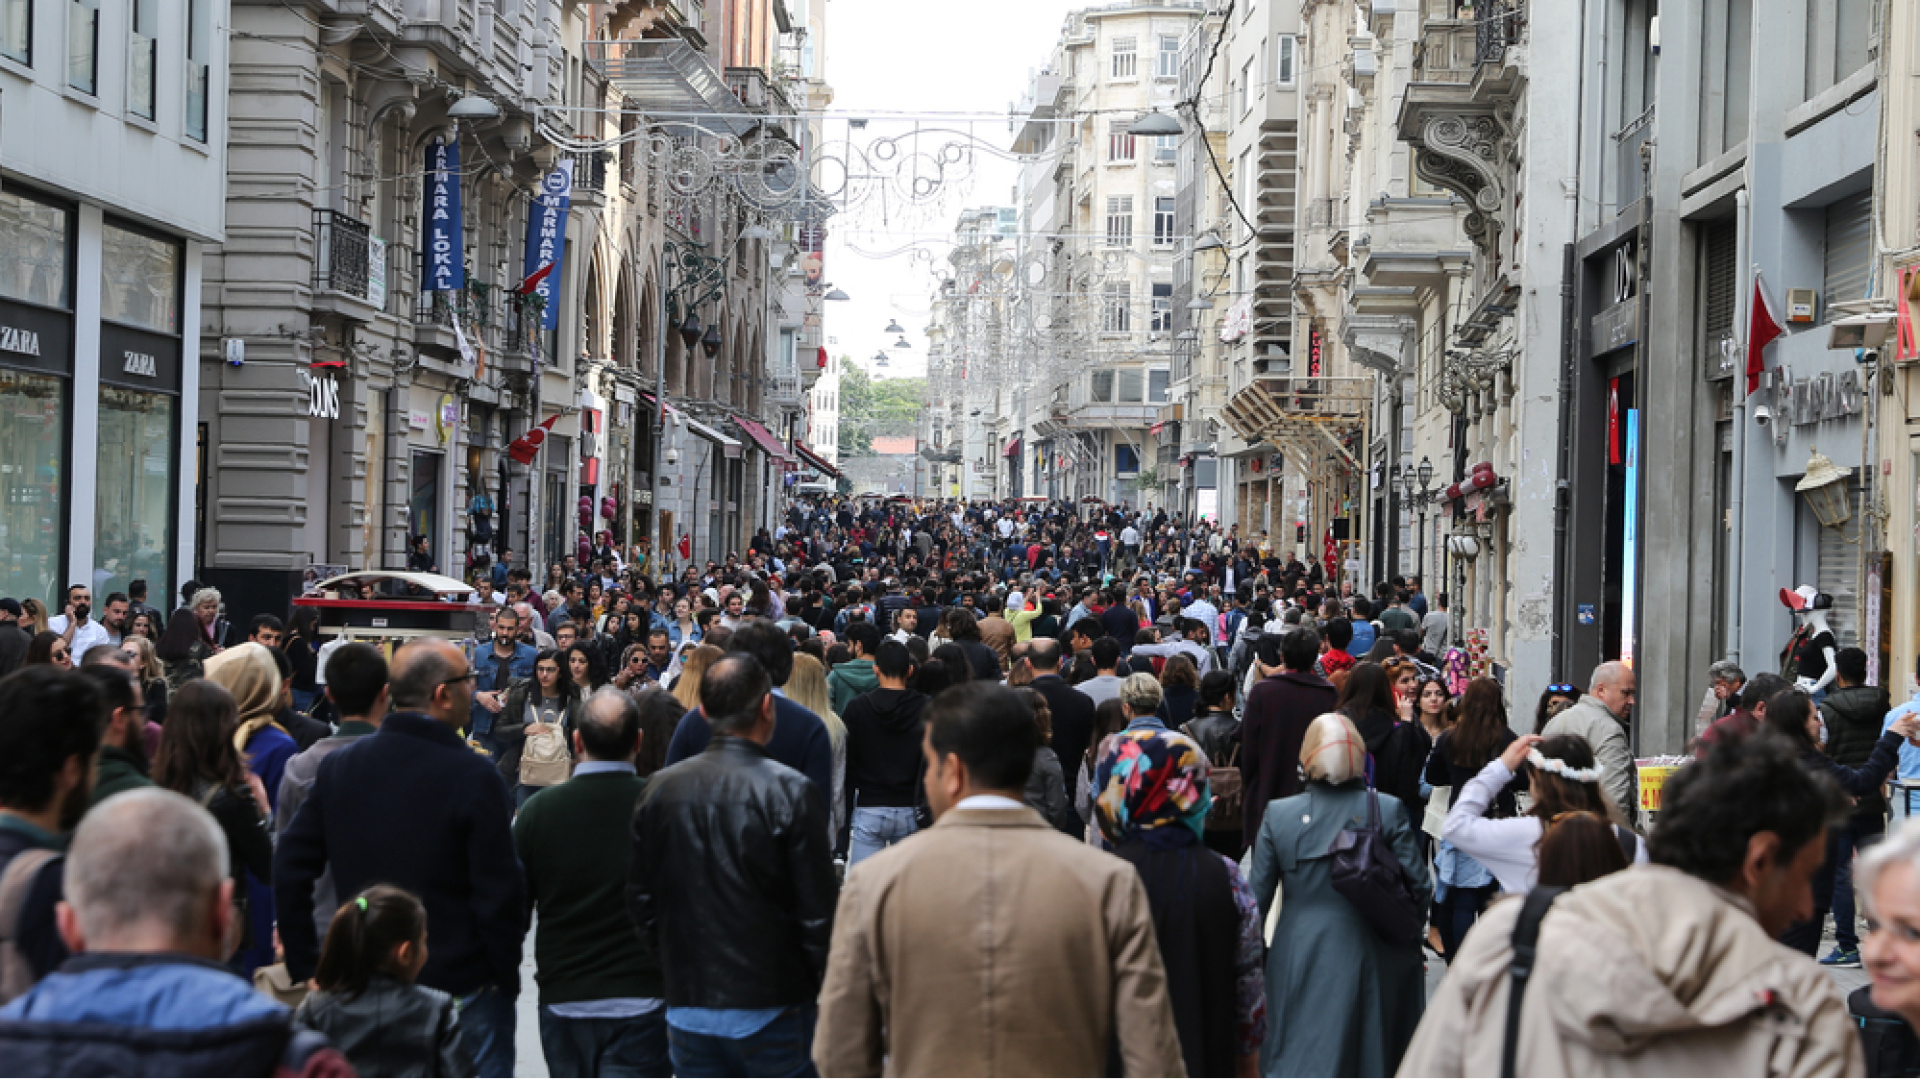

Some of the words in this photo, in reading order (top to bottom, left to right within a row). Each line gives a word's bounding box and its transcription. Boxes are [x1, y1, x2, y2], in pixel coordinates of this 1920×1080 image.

[433, 228, 452, 289] LOKAL
[0, 326, 40, 356] ZARA
[123, 350, 157, 377] ZARA
